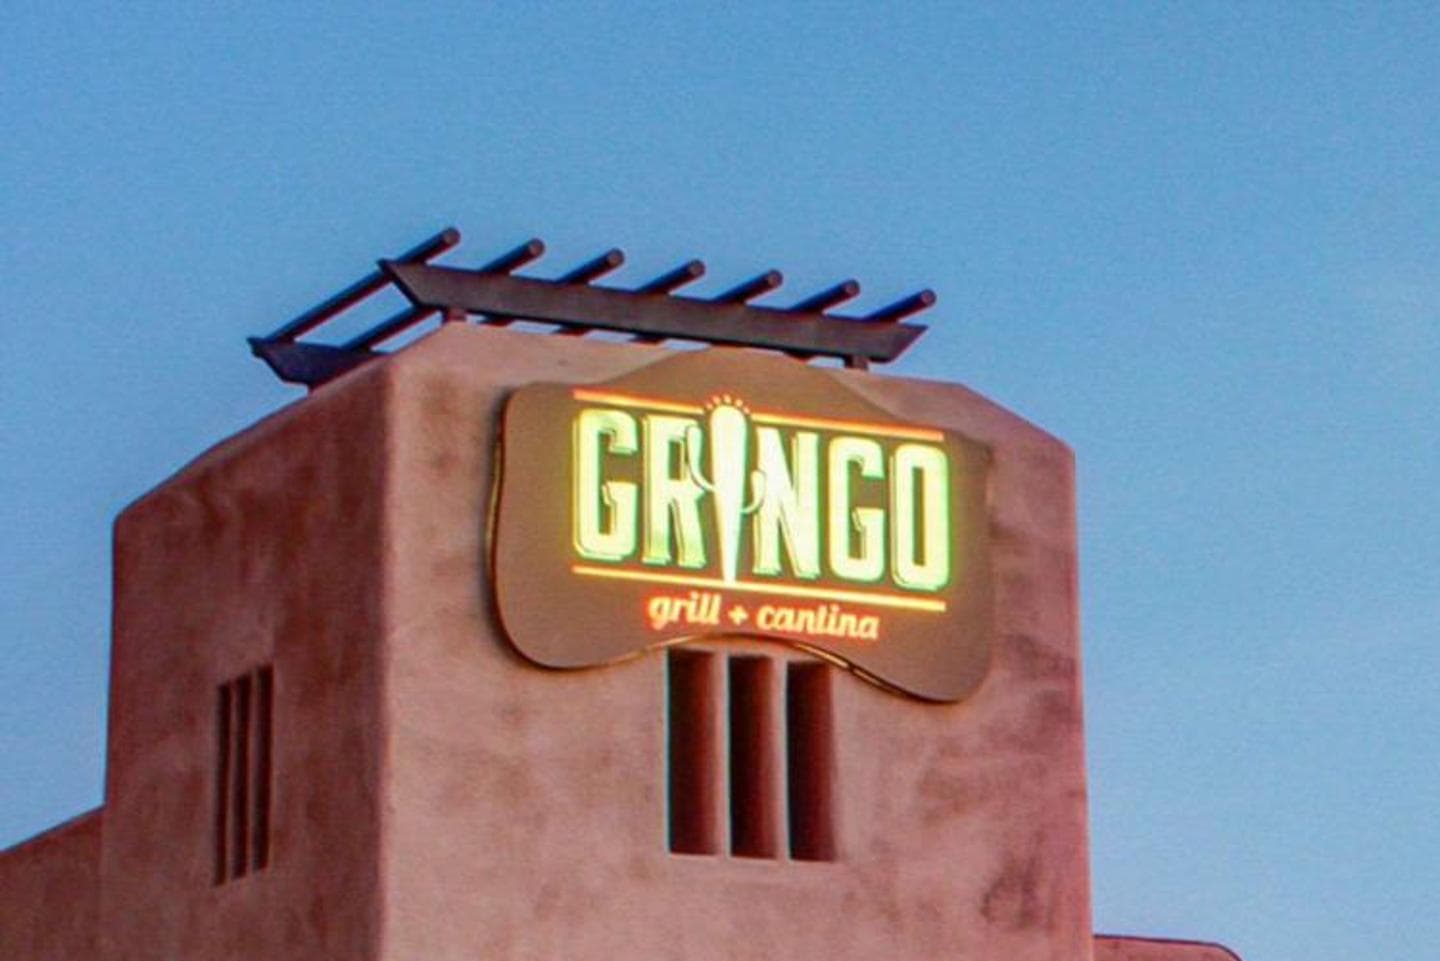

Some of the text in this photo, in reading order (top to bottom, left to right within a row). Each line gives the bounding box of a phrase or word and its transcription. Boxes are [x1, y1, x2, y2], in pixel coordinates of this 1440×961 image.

[571, 399, 953, 592] GRINGO
[649, 591, 721, 630] grill
[756, 604, 880, 639] cantina
